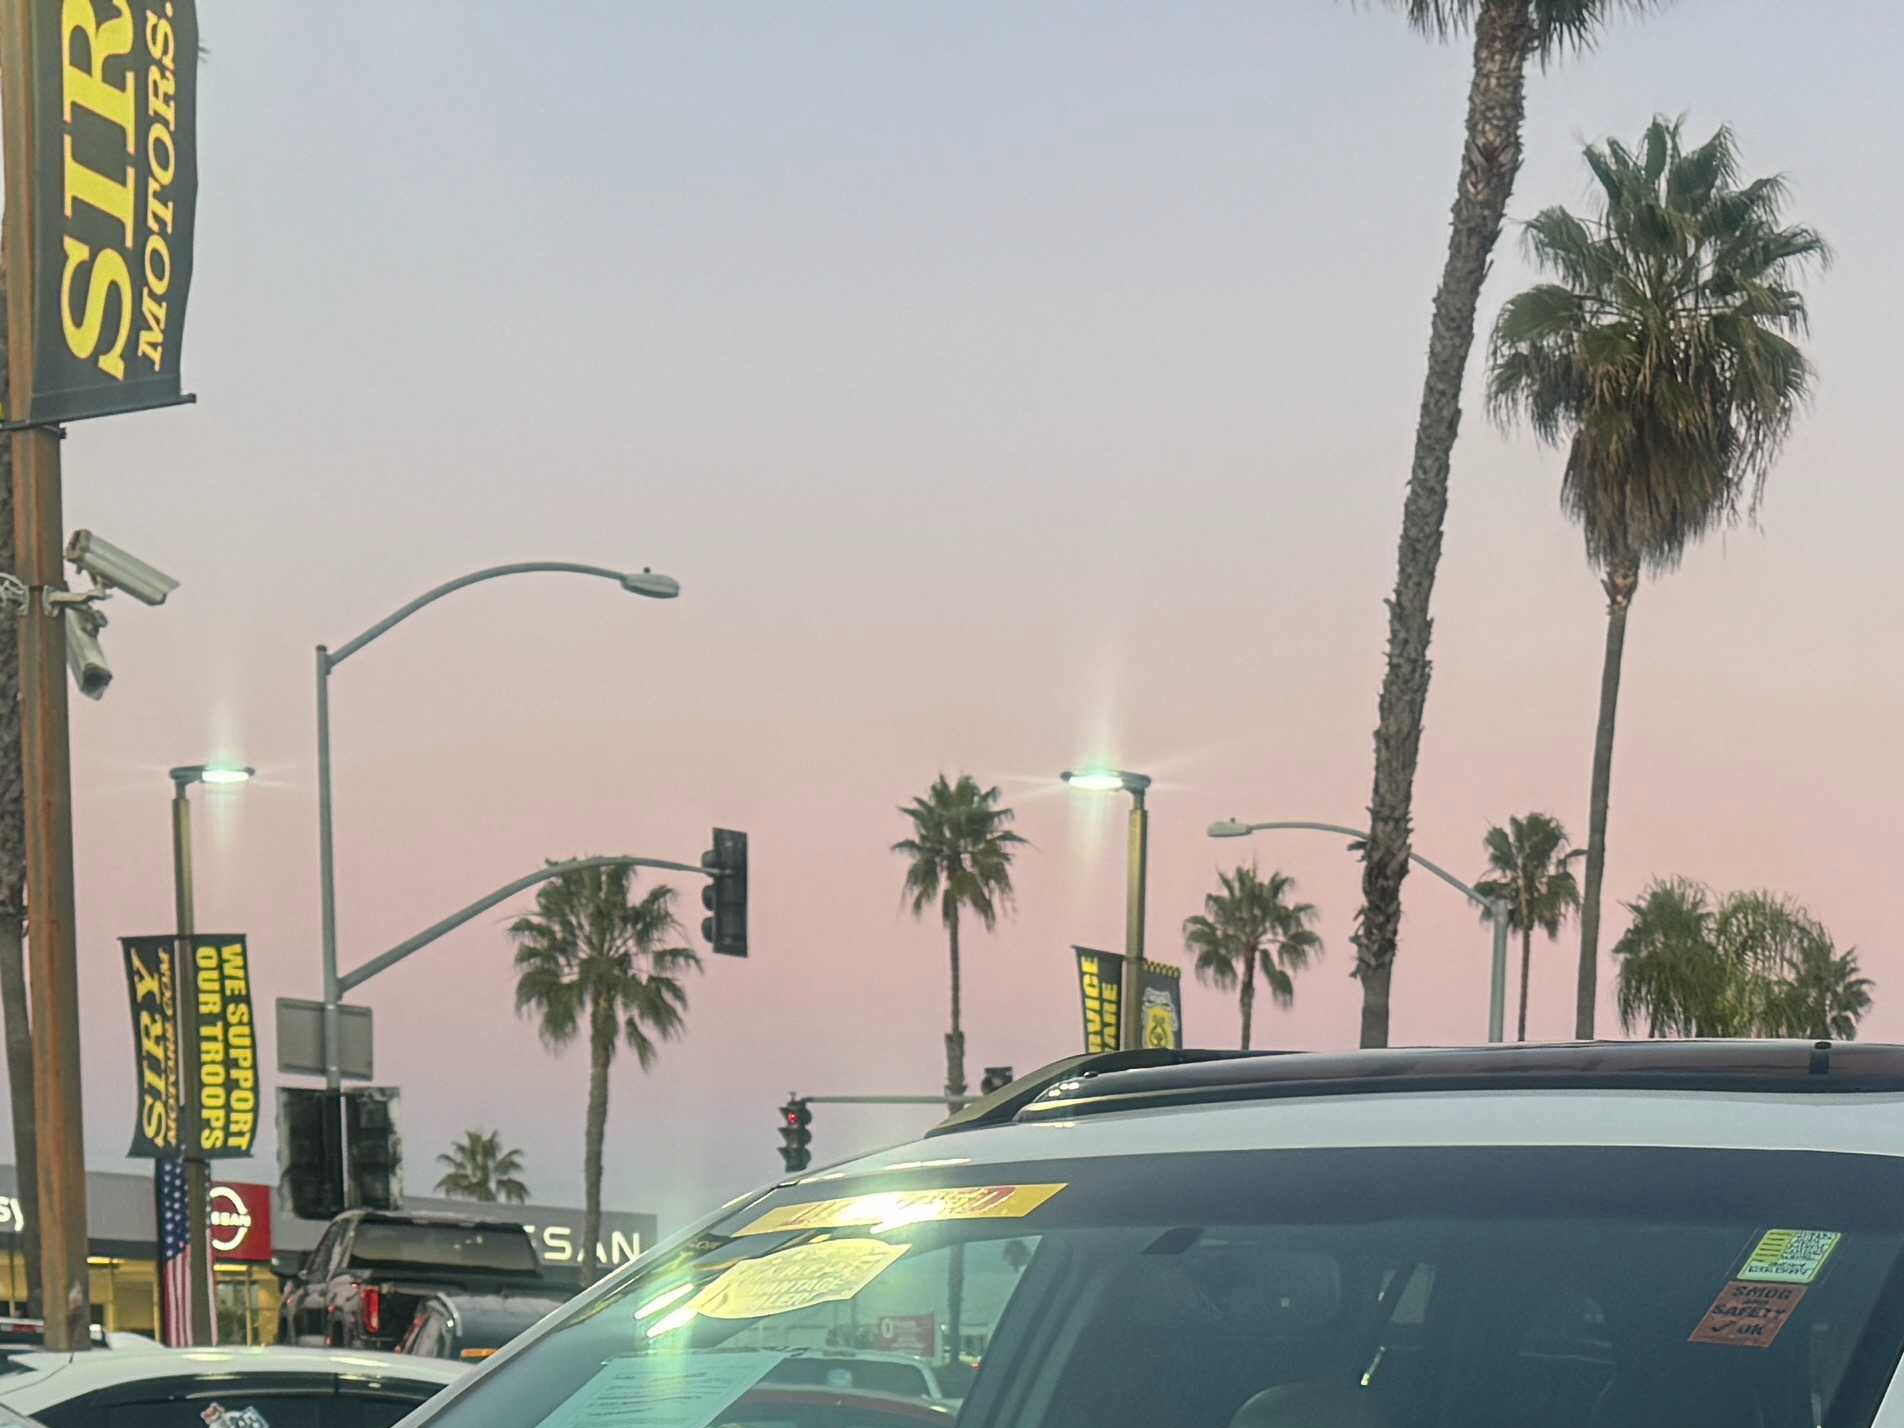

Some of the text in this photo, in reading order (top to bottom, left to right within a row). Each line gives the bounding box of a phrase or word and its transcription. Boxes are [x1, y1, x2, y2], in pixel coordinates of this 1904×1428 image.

[60, 0, 136, 381] SIR
[138, 0, 176, 371] MOTORS.
[130, 946, 167, 1149] SIRY
[196, 946, 226, 1150] OUR TROOPS
[221, 943, 255, 1151] WE SUPPORT
[1081, 957, 1103, 1055] RVICE
[1733, 1286, 1793, 1300] SMOG
